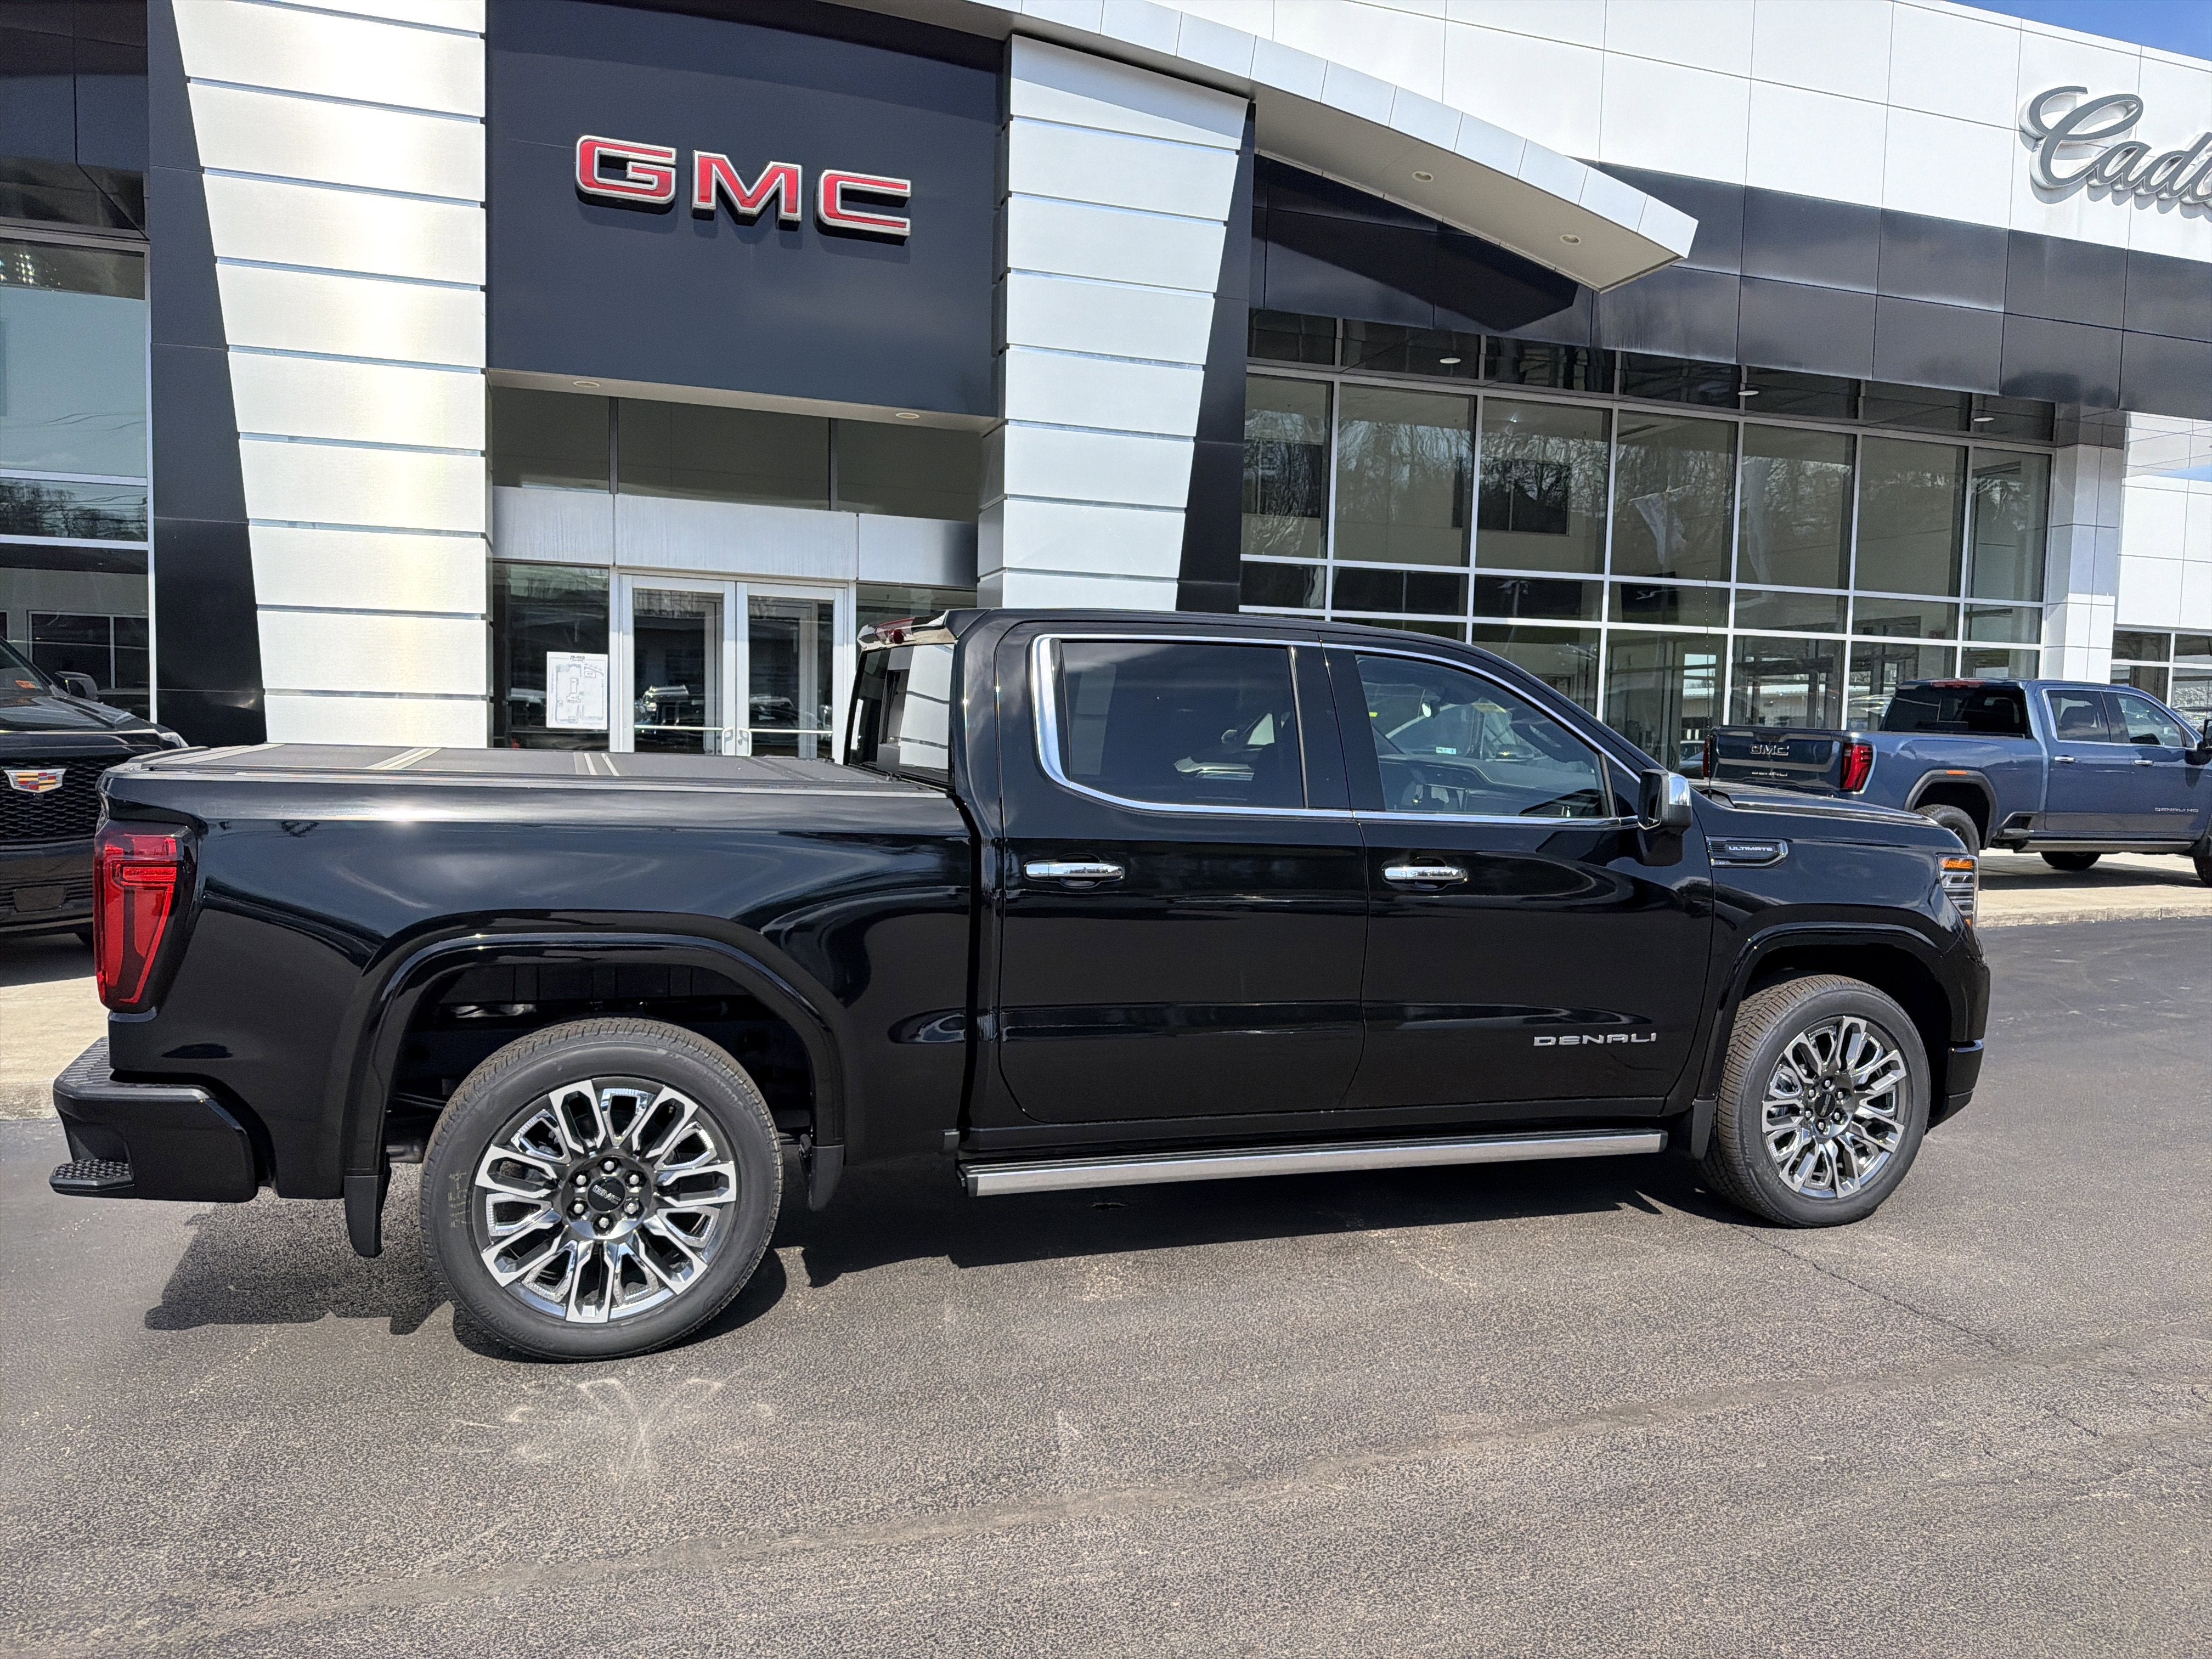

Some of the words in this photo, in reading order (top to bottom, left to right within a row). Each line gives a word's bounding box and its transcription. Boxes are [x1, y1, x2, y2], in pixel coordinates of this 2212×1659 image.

[574, 134, 911, 241] GMC
[1750, 744, 1790, 756] GMC
[1533, 1032, 1656, 1046] DENALI
[592, 1185, 621, 1204] GMC
